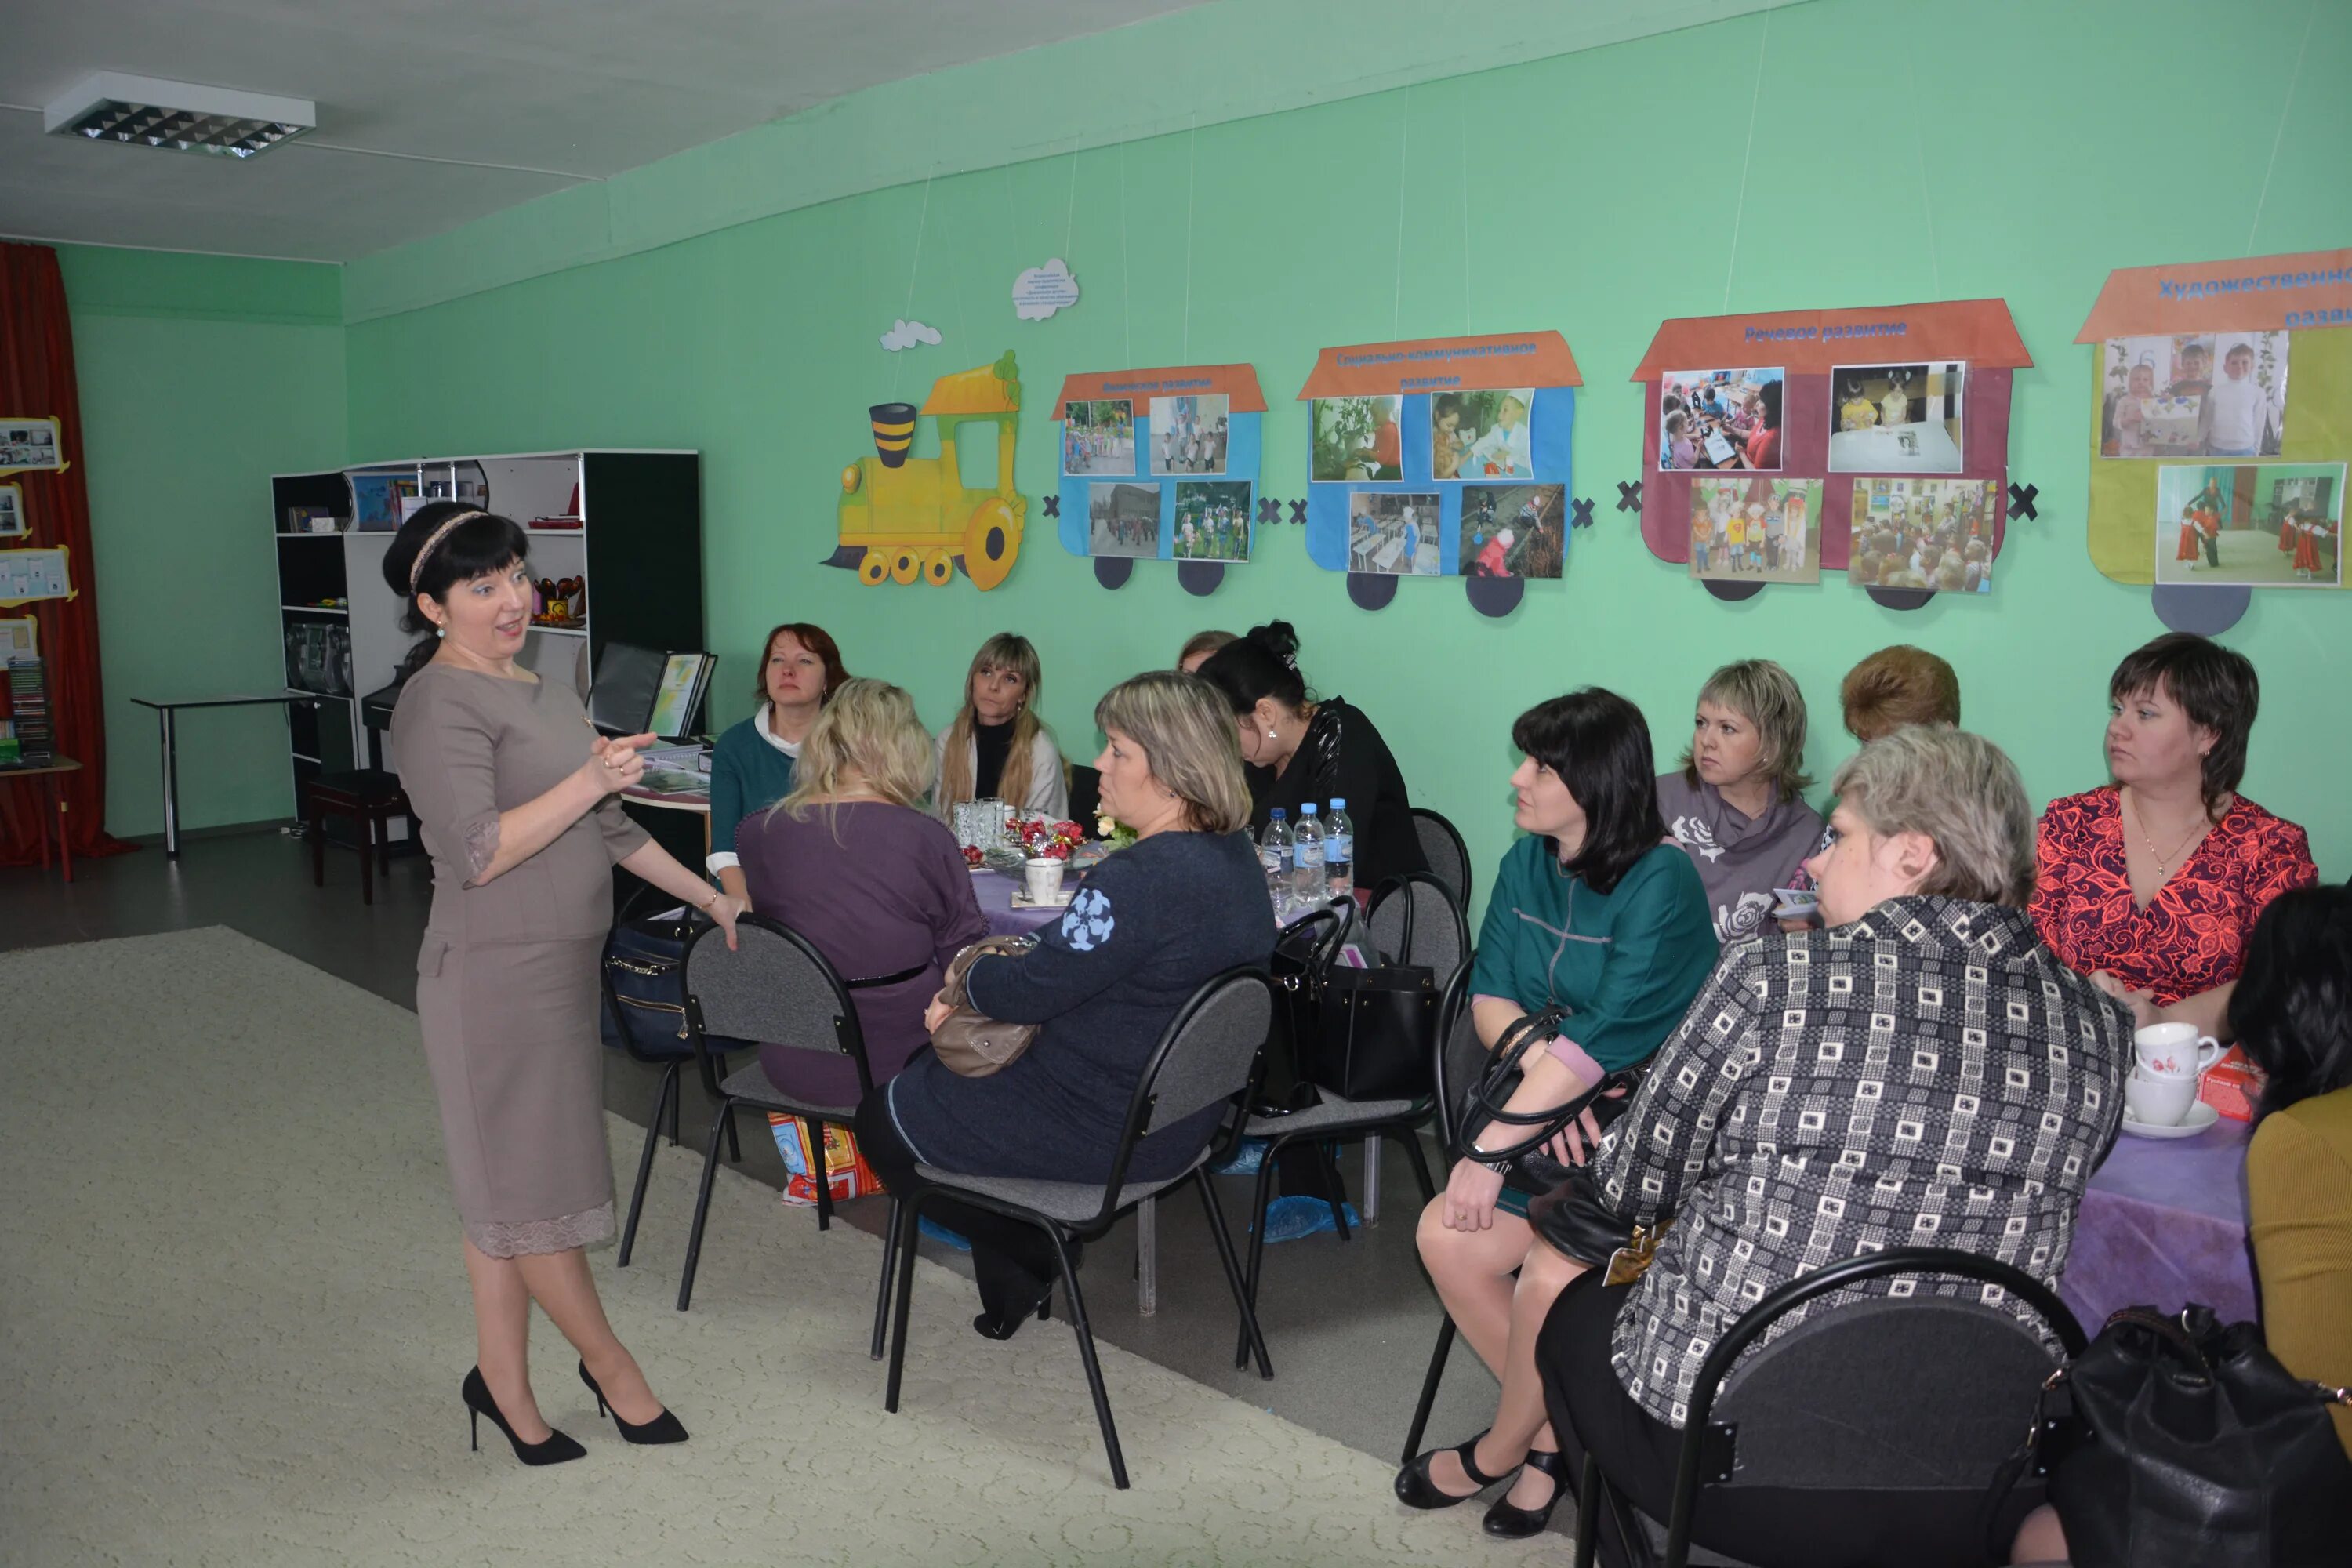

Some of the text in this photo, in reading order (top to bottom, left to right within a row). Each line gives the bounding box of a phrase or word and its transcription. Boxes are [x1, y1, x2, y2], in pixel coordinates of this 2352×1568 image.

[1744, 322, 1907, 343] Речевое развитие
[1336, 343, 1536, 368] Социально-коммуникативное
[1400, 375, 1461, 390] развитие
